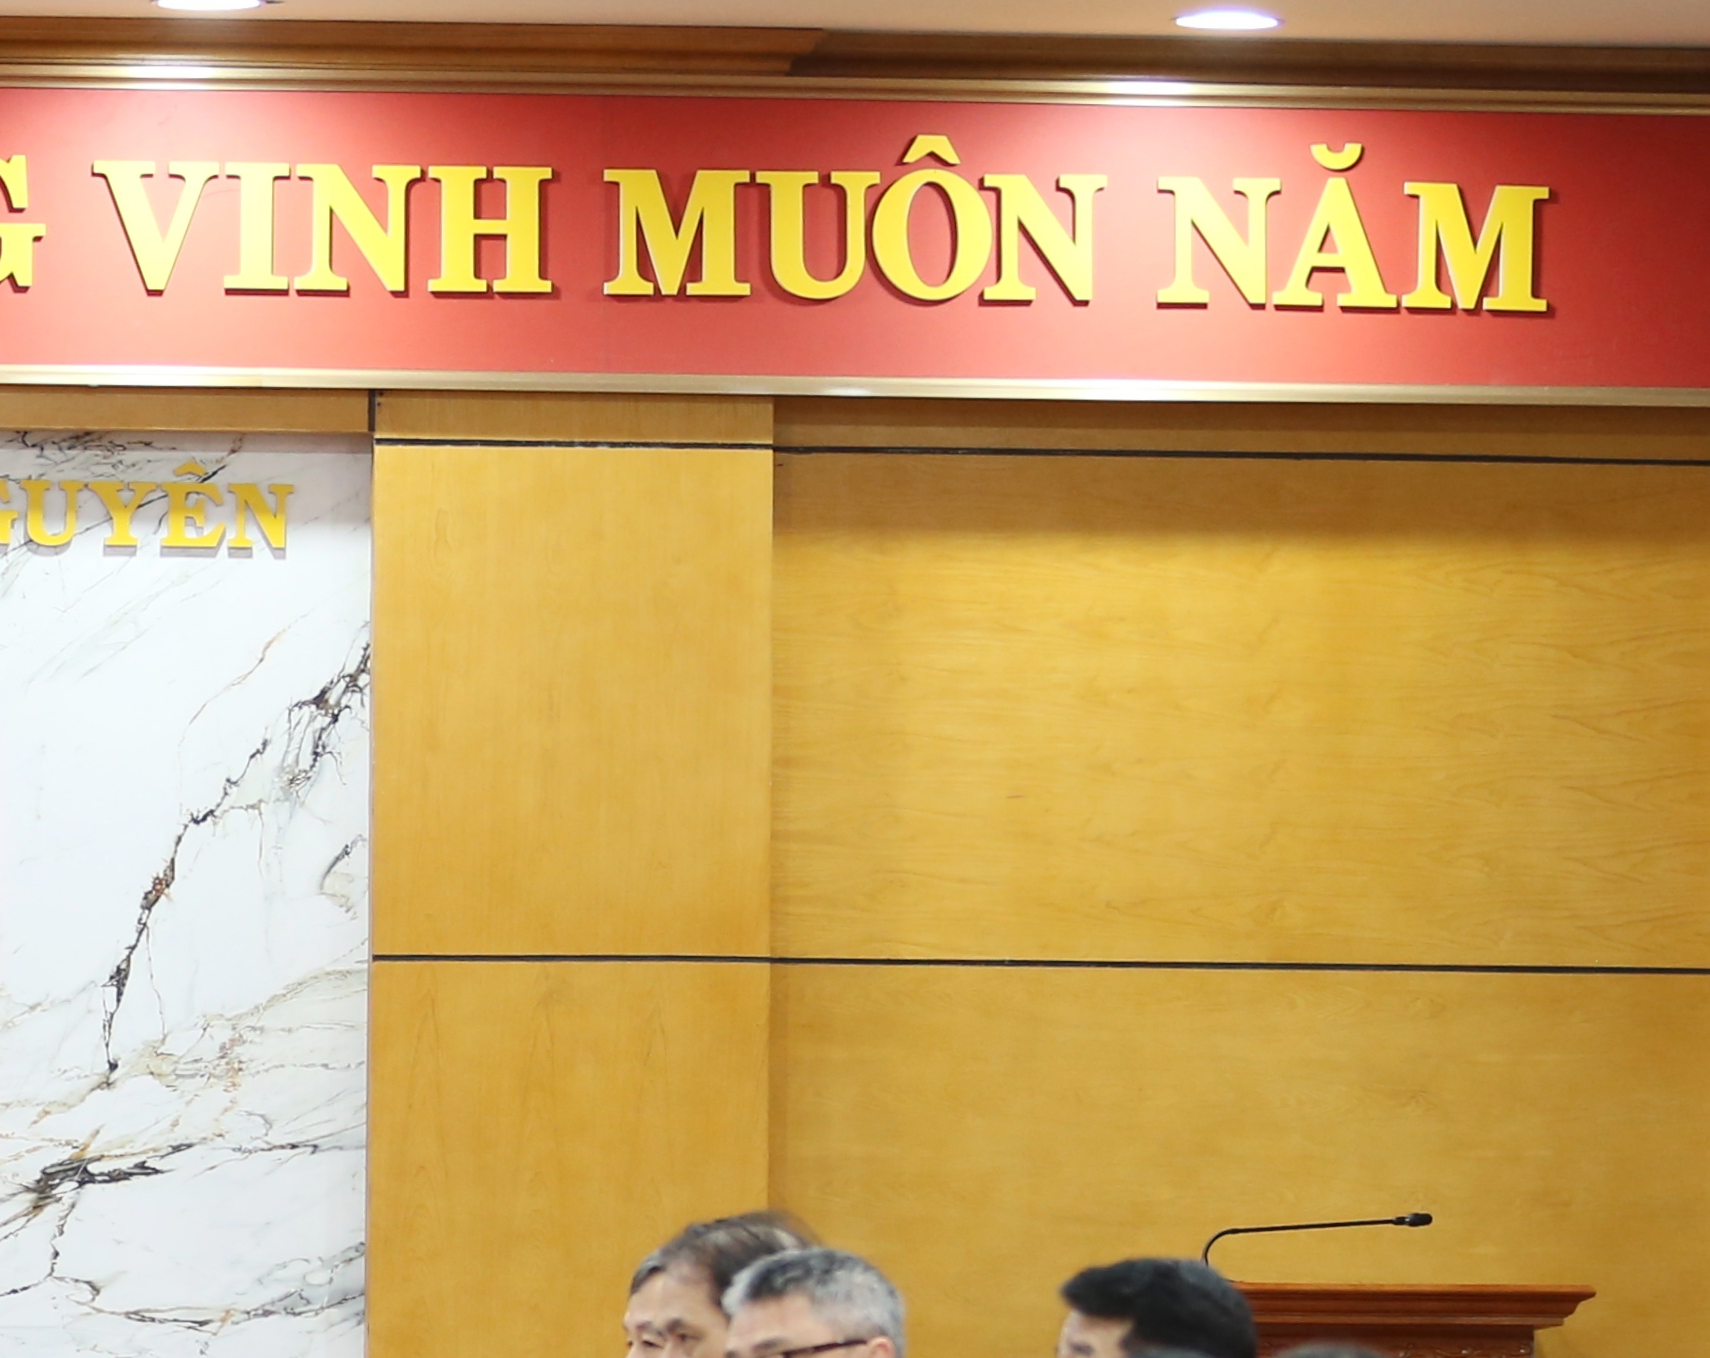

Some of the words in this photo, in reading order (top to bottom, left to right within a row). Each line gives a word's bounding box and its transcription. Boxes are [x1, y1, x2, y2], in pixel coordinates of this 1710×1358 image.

[97, 163, 552, 292] VINH
[605, 135, 1104, 300] MUÔN
[1157, 144, 1549, 311] NĂM
